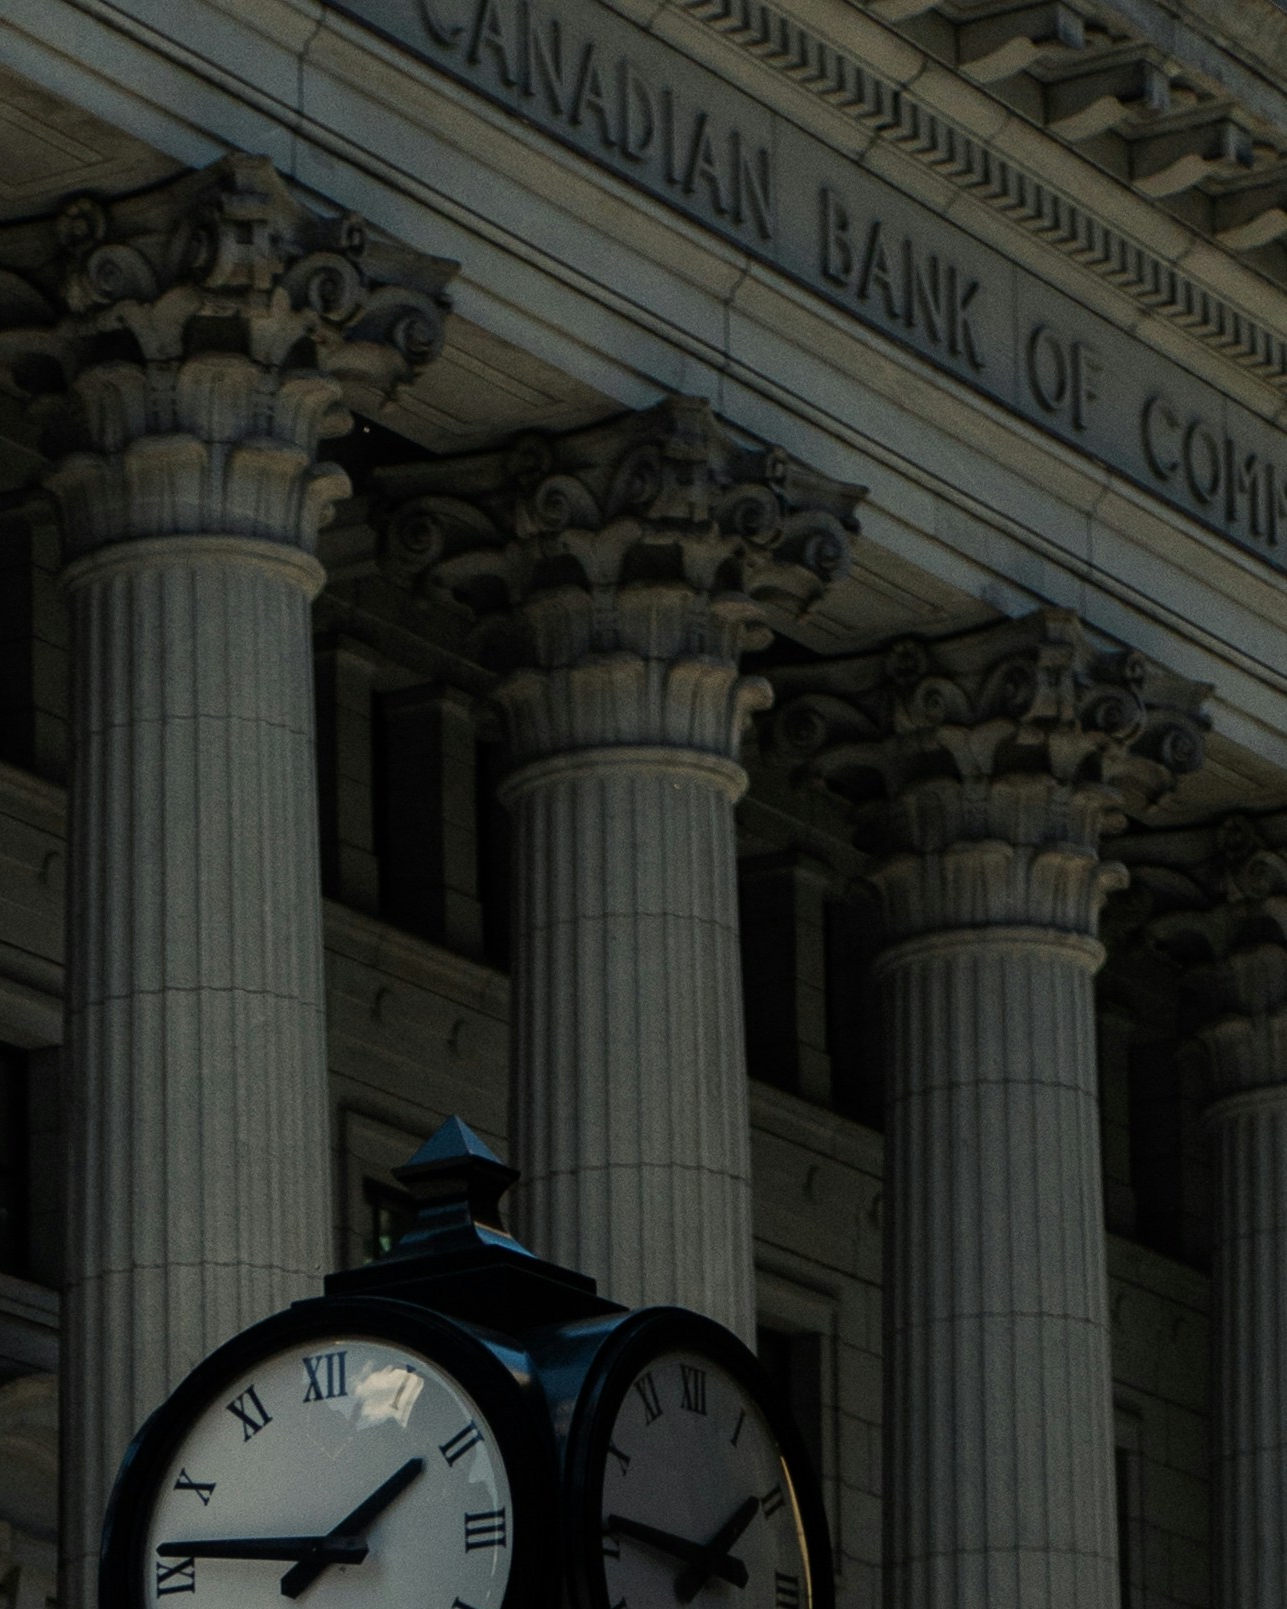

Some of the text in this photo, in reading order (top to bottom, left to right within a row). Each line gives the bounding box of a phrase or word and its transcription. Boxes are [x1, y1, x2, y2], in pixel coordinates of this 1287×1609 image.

[819, 184, 985, 371] BANK
[1026, 321, 1104, 432] OF
[303, 1351, 348, 1403] XII
[635, 1371, 663, 1426] XI
[680, 1363, 707, 1416] XII
[226, 1384, 273, 1442] XI
[438, 1421, 485, 1468] II
[173, 1468, 216, 1506] X
[465, 1507, 506, 1553] III
